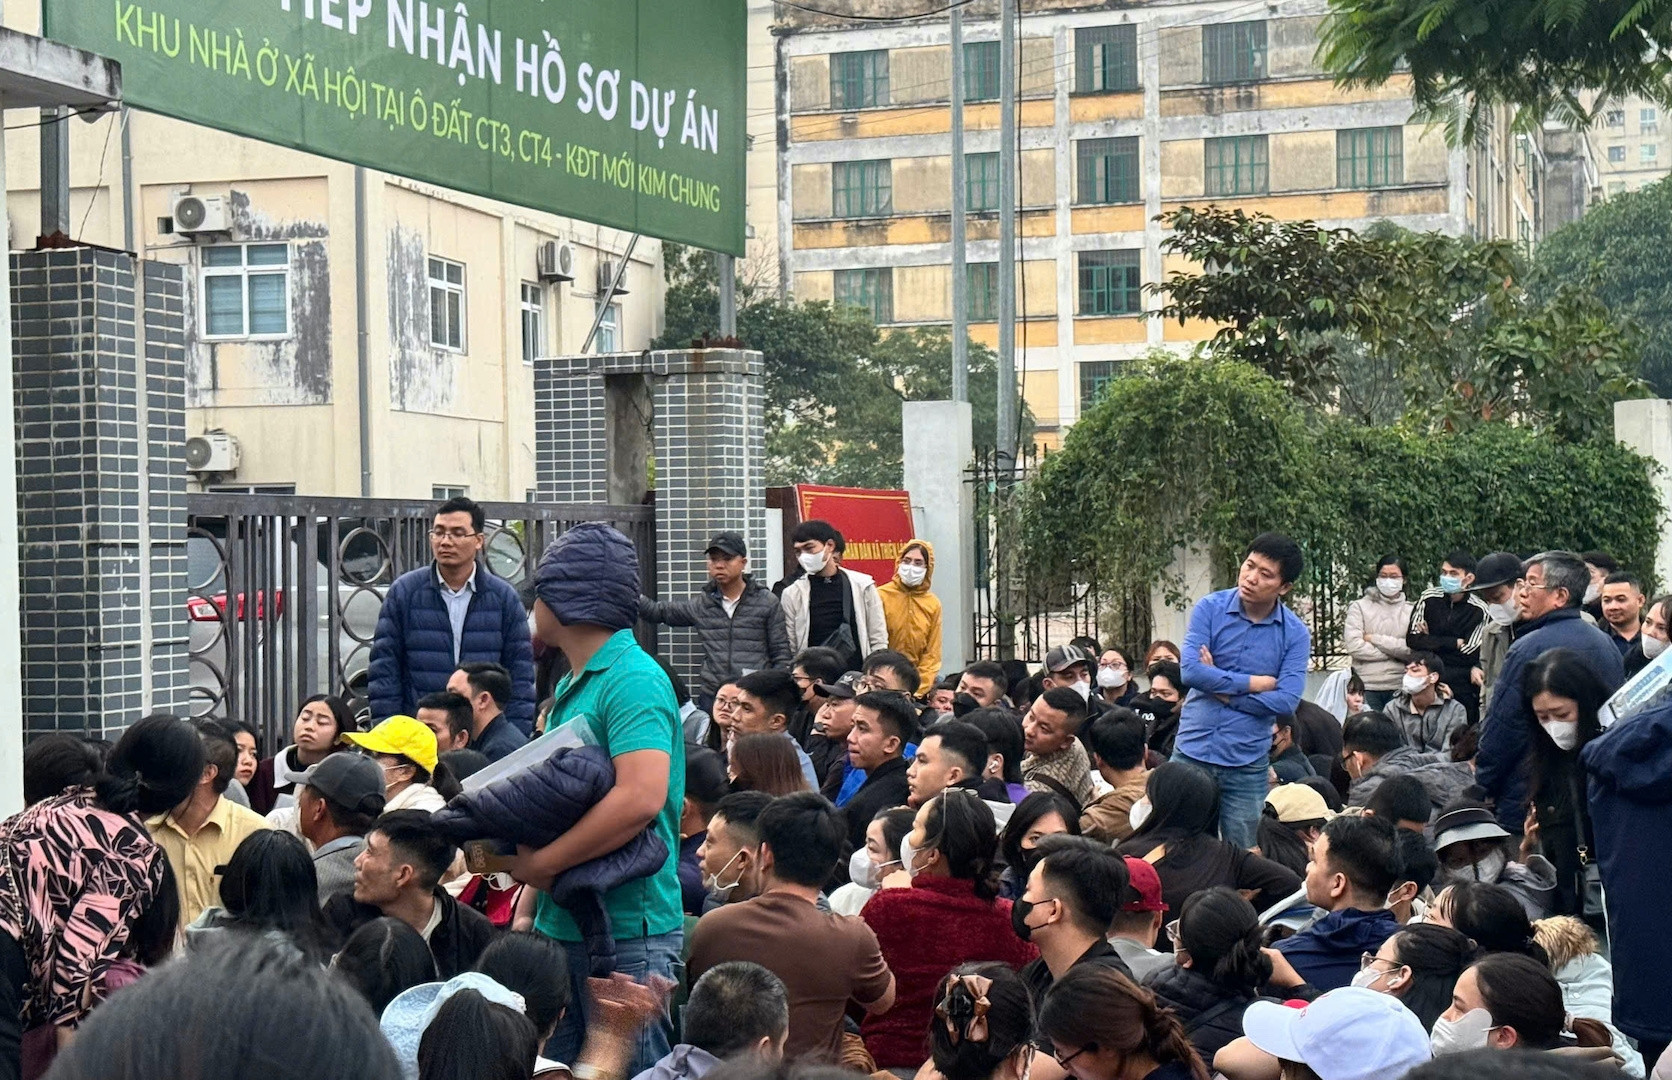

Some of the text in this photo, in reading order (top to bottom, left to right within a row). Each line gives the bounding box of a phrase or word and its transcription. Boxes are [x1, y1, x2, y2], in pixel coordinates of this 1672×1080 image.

[115, 0, 180, 58] KHU
[189, 24, 252, 81] NHÀ
[256, 37, 279, 87] Ở
[284, 52, 319, 101] XÃ
[324, 66, 367, 120] HỘI
[371, 82, 404, 131] TẠI
[410, 88, 428, 131] Ô
[431, 98, 472, 144] ĐẤT
[475, 116, 515, 162] CT3,
[518, 130, 553, 168] CT4
[566, 142, 600, 182] KĐT
[602, 151, 635, 192] MỚI
[638, 162, 667, 199] KIM
[669, 173, 721, 213] CHUNG
[387, 0, 501, 87] NHẬN
[516, 30, 567, 104] HỒ
[577, 62, 621, 121] SƠ
[630, 79, 676, 150] DỰ
[680, 88, 719, 155] ÁN
